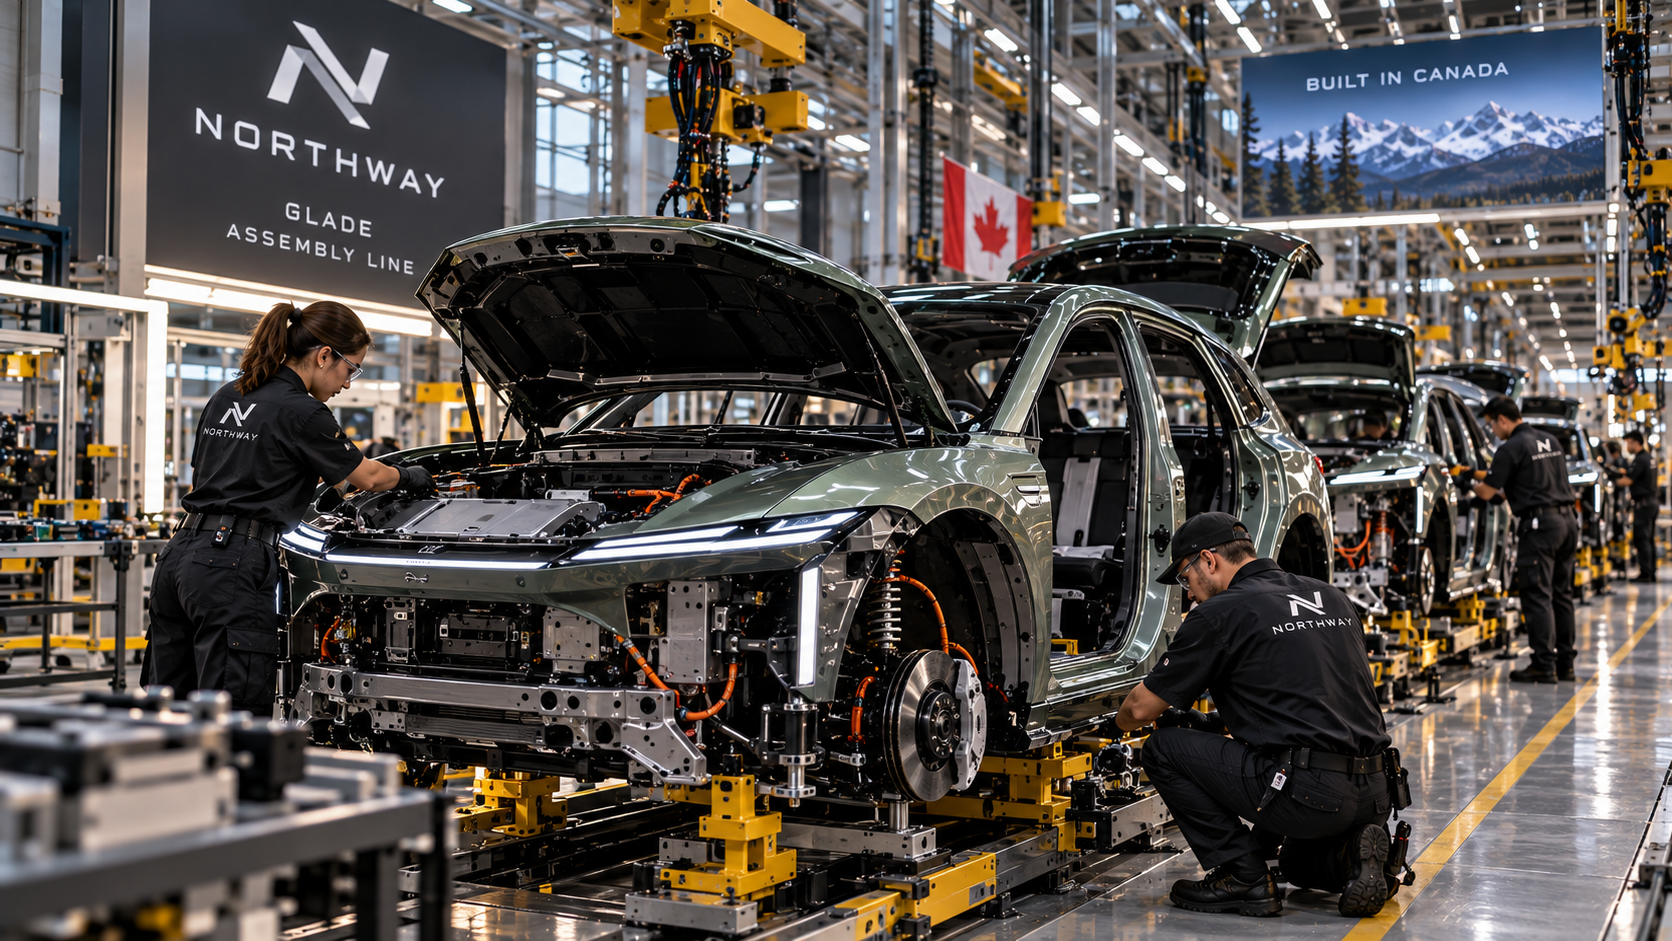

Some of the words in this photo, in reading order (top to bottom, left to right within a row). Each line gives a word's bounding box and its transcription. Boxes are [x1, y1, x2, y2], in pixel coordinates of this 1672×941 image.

[1307, 73, 1369, 91] BUILT
[1381, 71, 1402, 86] IN
[1414, 62, 1509, 83] CANADA
[195, 107, 445, 198] NORTHWAY
[285, 202, 372, 237] GLADE
[227, 223, 355, 262] ASSEMBLY
[368, 252, 414, 275] LINE
[202, 427, 259, 441] NORTHWAY
[1271, 618, 1352, 635] NORTHWAY
